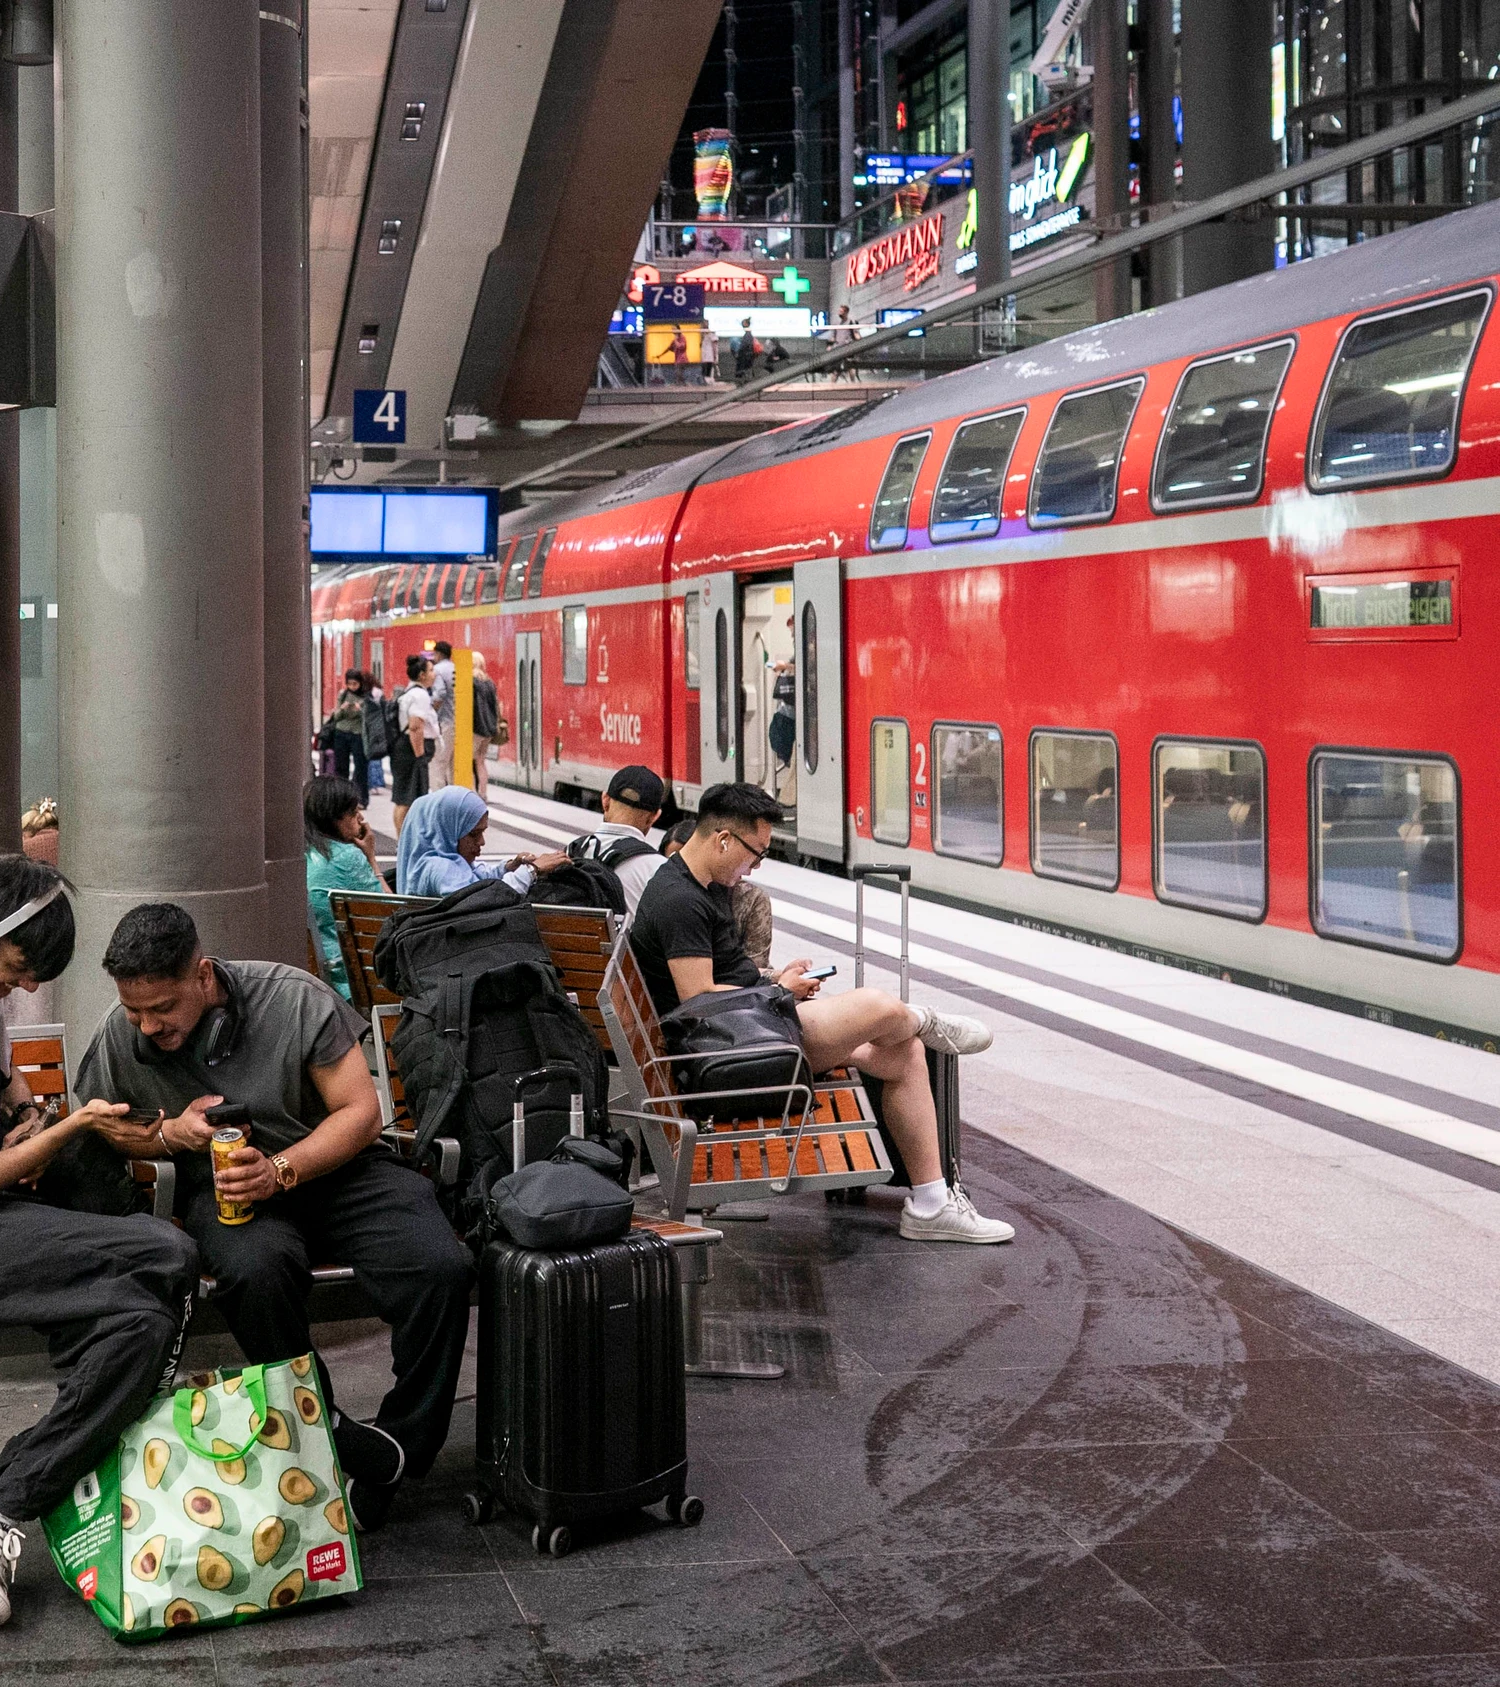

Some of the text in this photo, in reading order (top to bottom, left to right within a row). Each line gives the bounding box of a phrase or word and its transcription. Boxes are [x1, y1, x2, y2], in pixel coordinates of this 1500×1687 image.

[846, 212, 942, 287] ROSSMANN
[651, 286, 687, 307] 7-8
[373, 392, 399, 431] 4
[601, 702, 641, 745] Service
[915, 742, 927, 785] 2
[312, 1547, 340, 1566] REWE
[313, 1559, 342, 1574] Dein Markt
